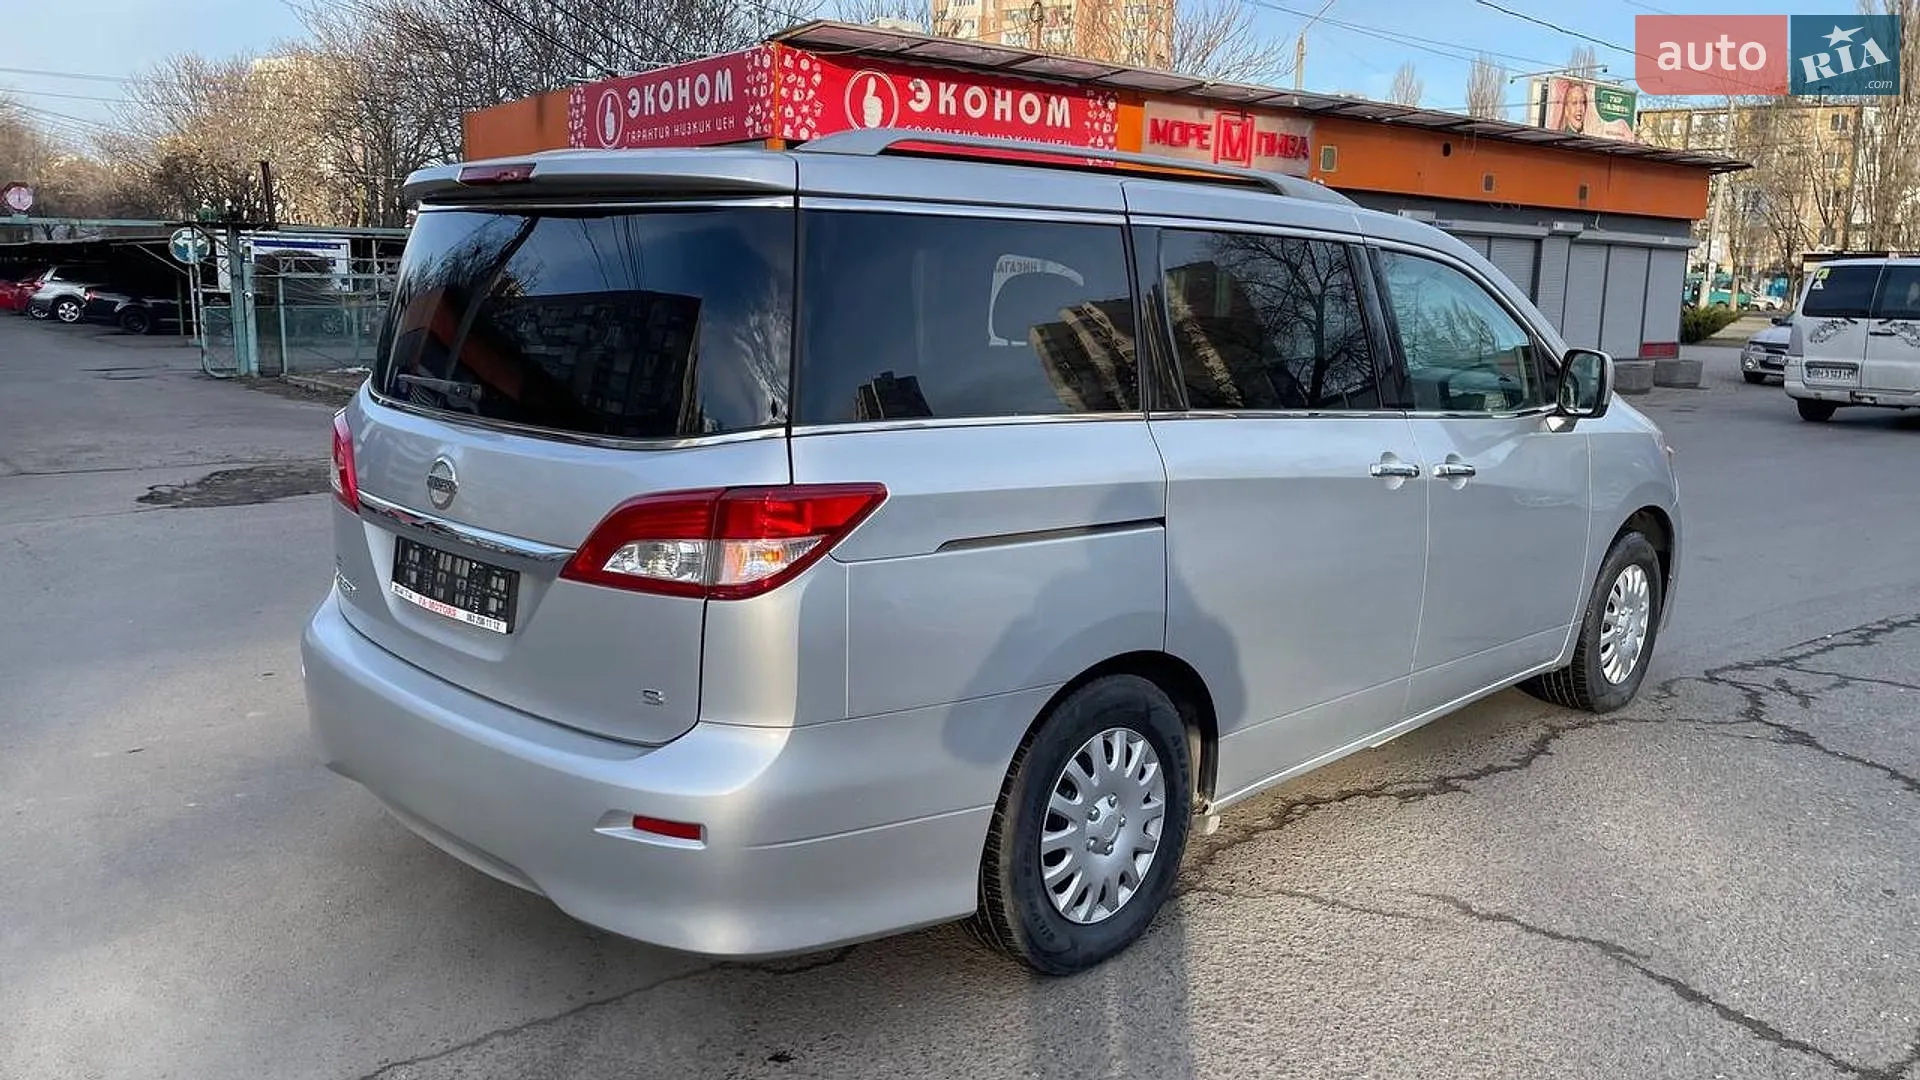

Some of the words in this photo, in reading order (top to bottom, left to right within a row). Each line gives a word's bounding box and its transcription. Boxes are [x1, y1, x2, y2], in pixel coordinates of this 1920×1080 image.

[627, 67, 734, 119] ЭКОНОМ
[907, 78, 1072, 129] ЭКОНОМ
[626, 125, 672, 144] ГАРАНТИЯ
[673, 121, 711, 139] НИЗКИХ
[715, 115, 736, 132] ЦЕН
[1149, 118, 1212, 150] МОРЕ
[1256, 131, 1311, 160] ПИВА
[995, 261, 1039, 274] АГАЗИН
